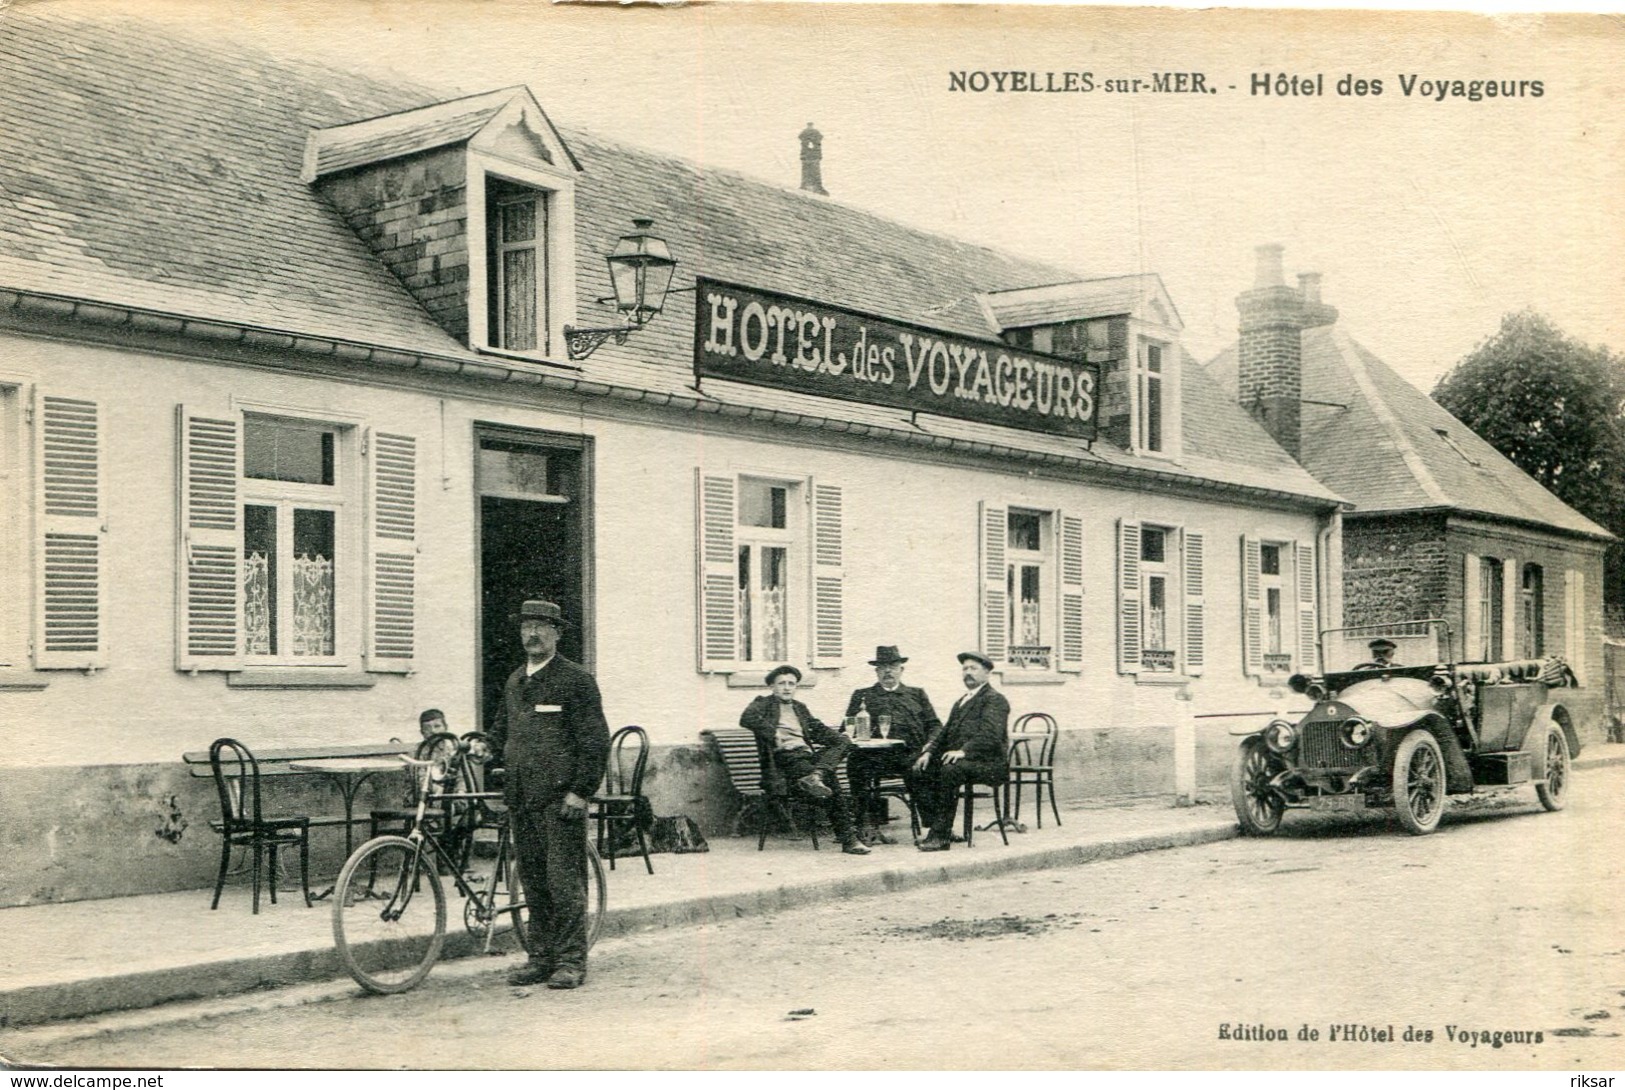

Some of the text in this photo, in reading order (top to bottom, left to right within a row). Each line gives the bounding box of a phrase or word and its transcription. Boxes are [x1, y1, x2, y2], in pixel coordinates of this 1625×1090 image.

[704, 292, 1095, 422] HOTEL des VOYAGEURS
